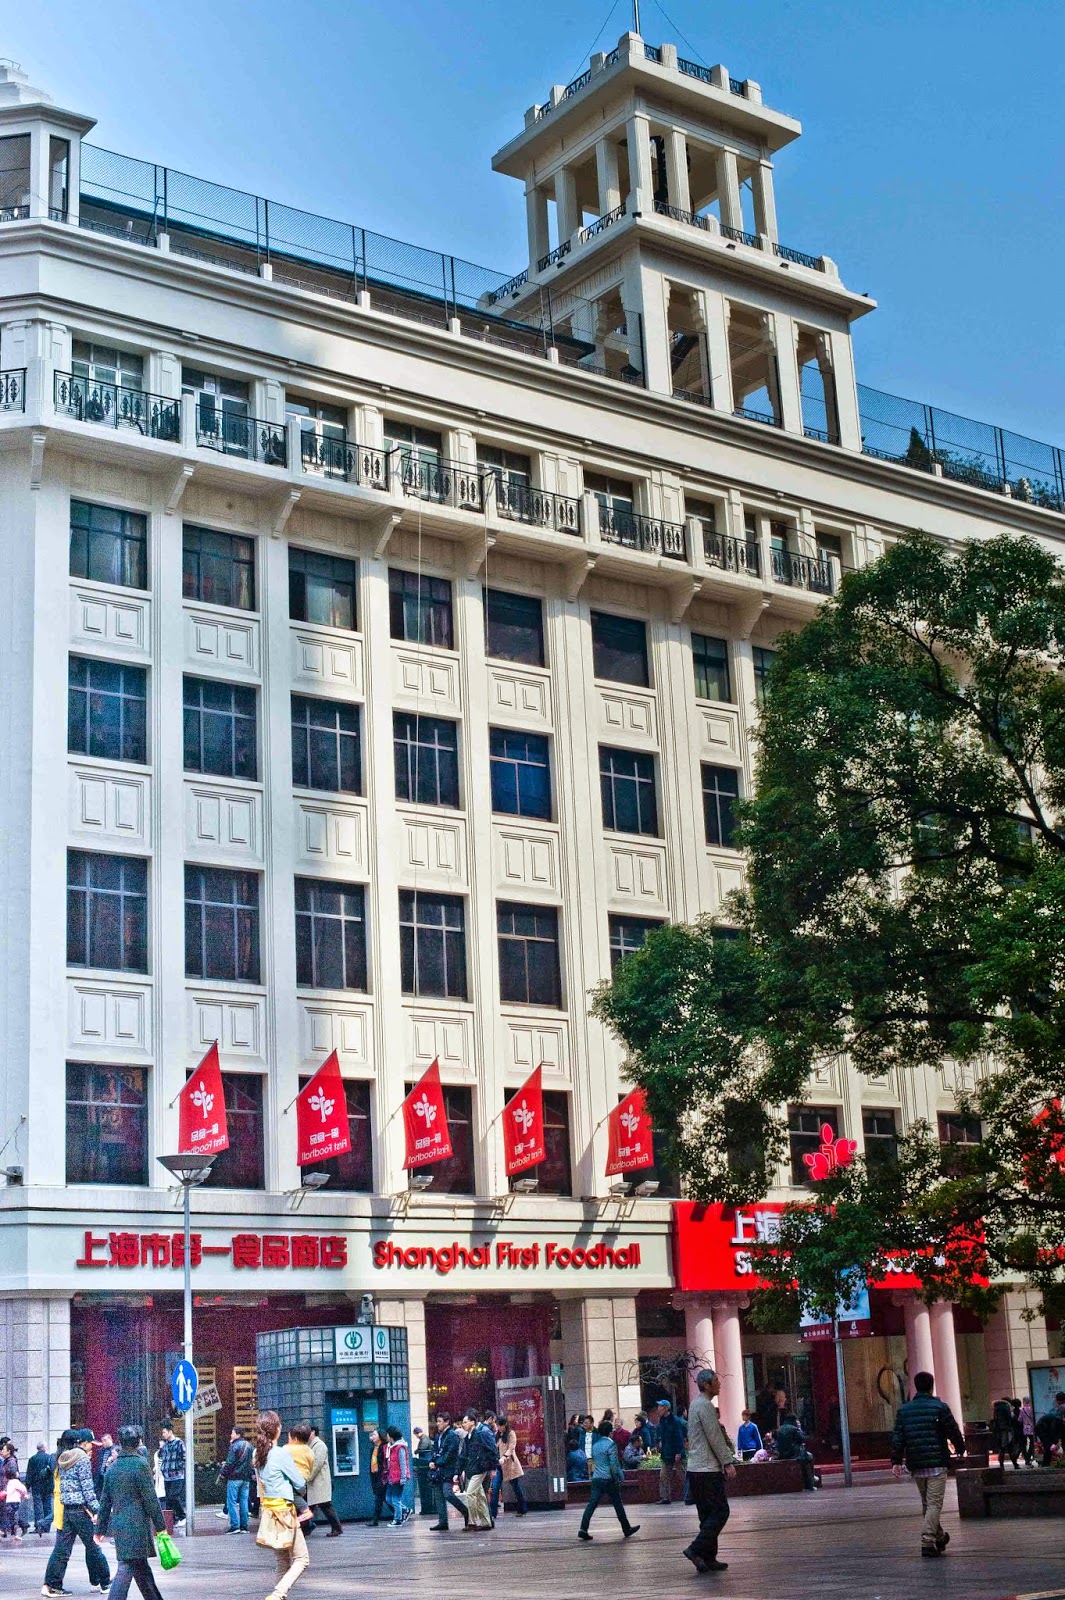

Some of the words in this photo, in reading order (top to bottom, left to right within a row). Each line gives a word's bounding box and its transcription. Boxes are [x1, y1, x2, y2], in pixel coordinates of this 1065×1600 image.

[76, 1231, 347, 1268] 上海市第一食品商店
[374, 1240, 491, 1273] Shanghai
[496, 1242, 540, 1266] First
[545, 1243, 641, 1266] Foodhall
